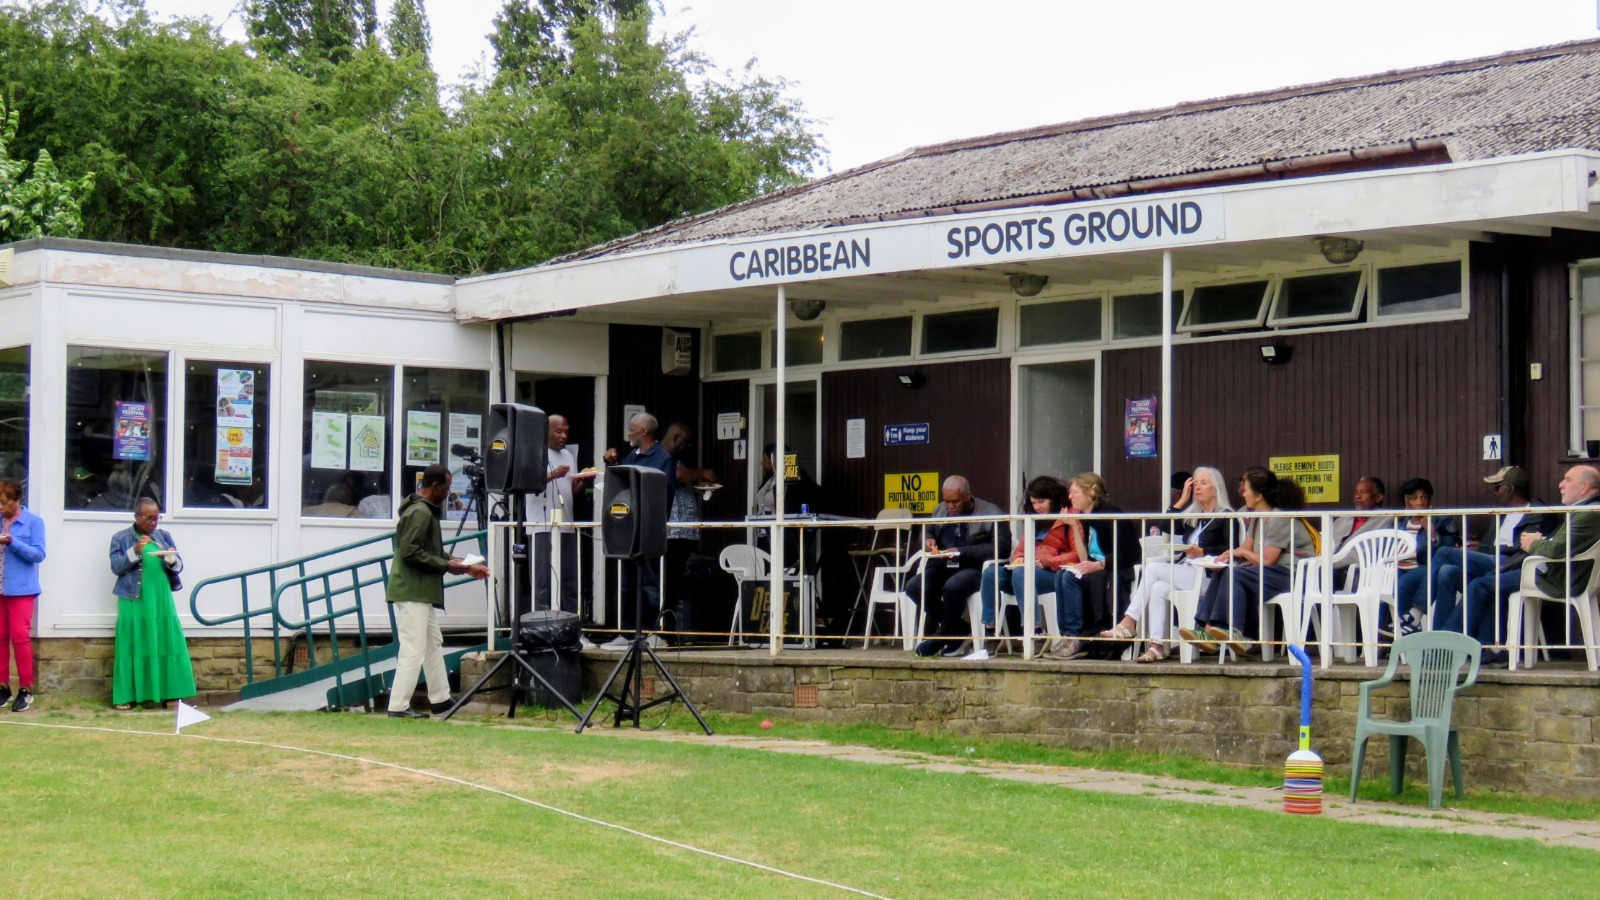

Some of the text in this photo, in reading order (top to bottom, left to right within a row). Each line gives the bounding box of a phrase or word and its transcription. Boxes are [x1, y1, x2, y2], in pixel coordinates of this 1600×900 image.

[730, 200, 1203, 281] CARIBBEAN SPORTS GROUND
[1273, 461, 1335, 471] PLEASE REMOVE BOOTS
[901, 474, 922, 492] NO
[1296, 474, 1321, 483] ENTERING
[1323, 474, 1333, 482] THE
[1308, 486, 1324, 494] ROOM
[888, 491, 936, 502] FOOTBALL BOOTS
